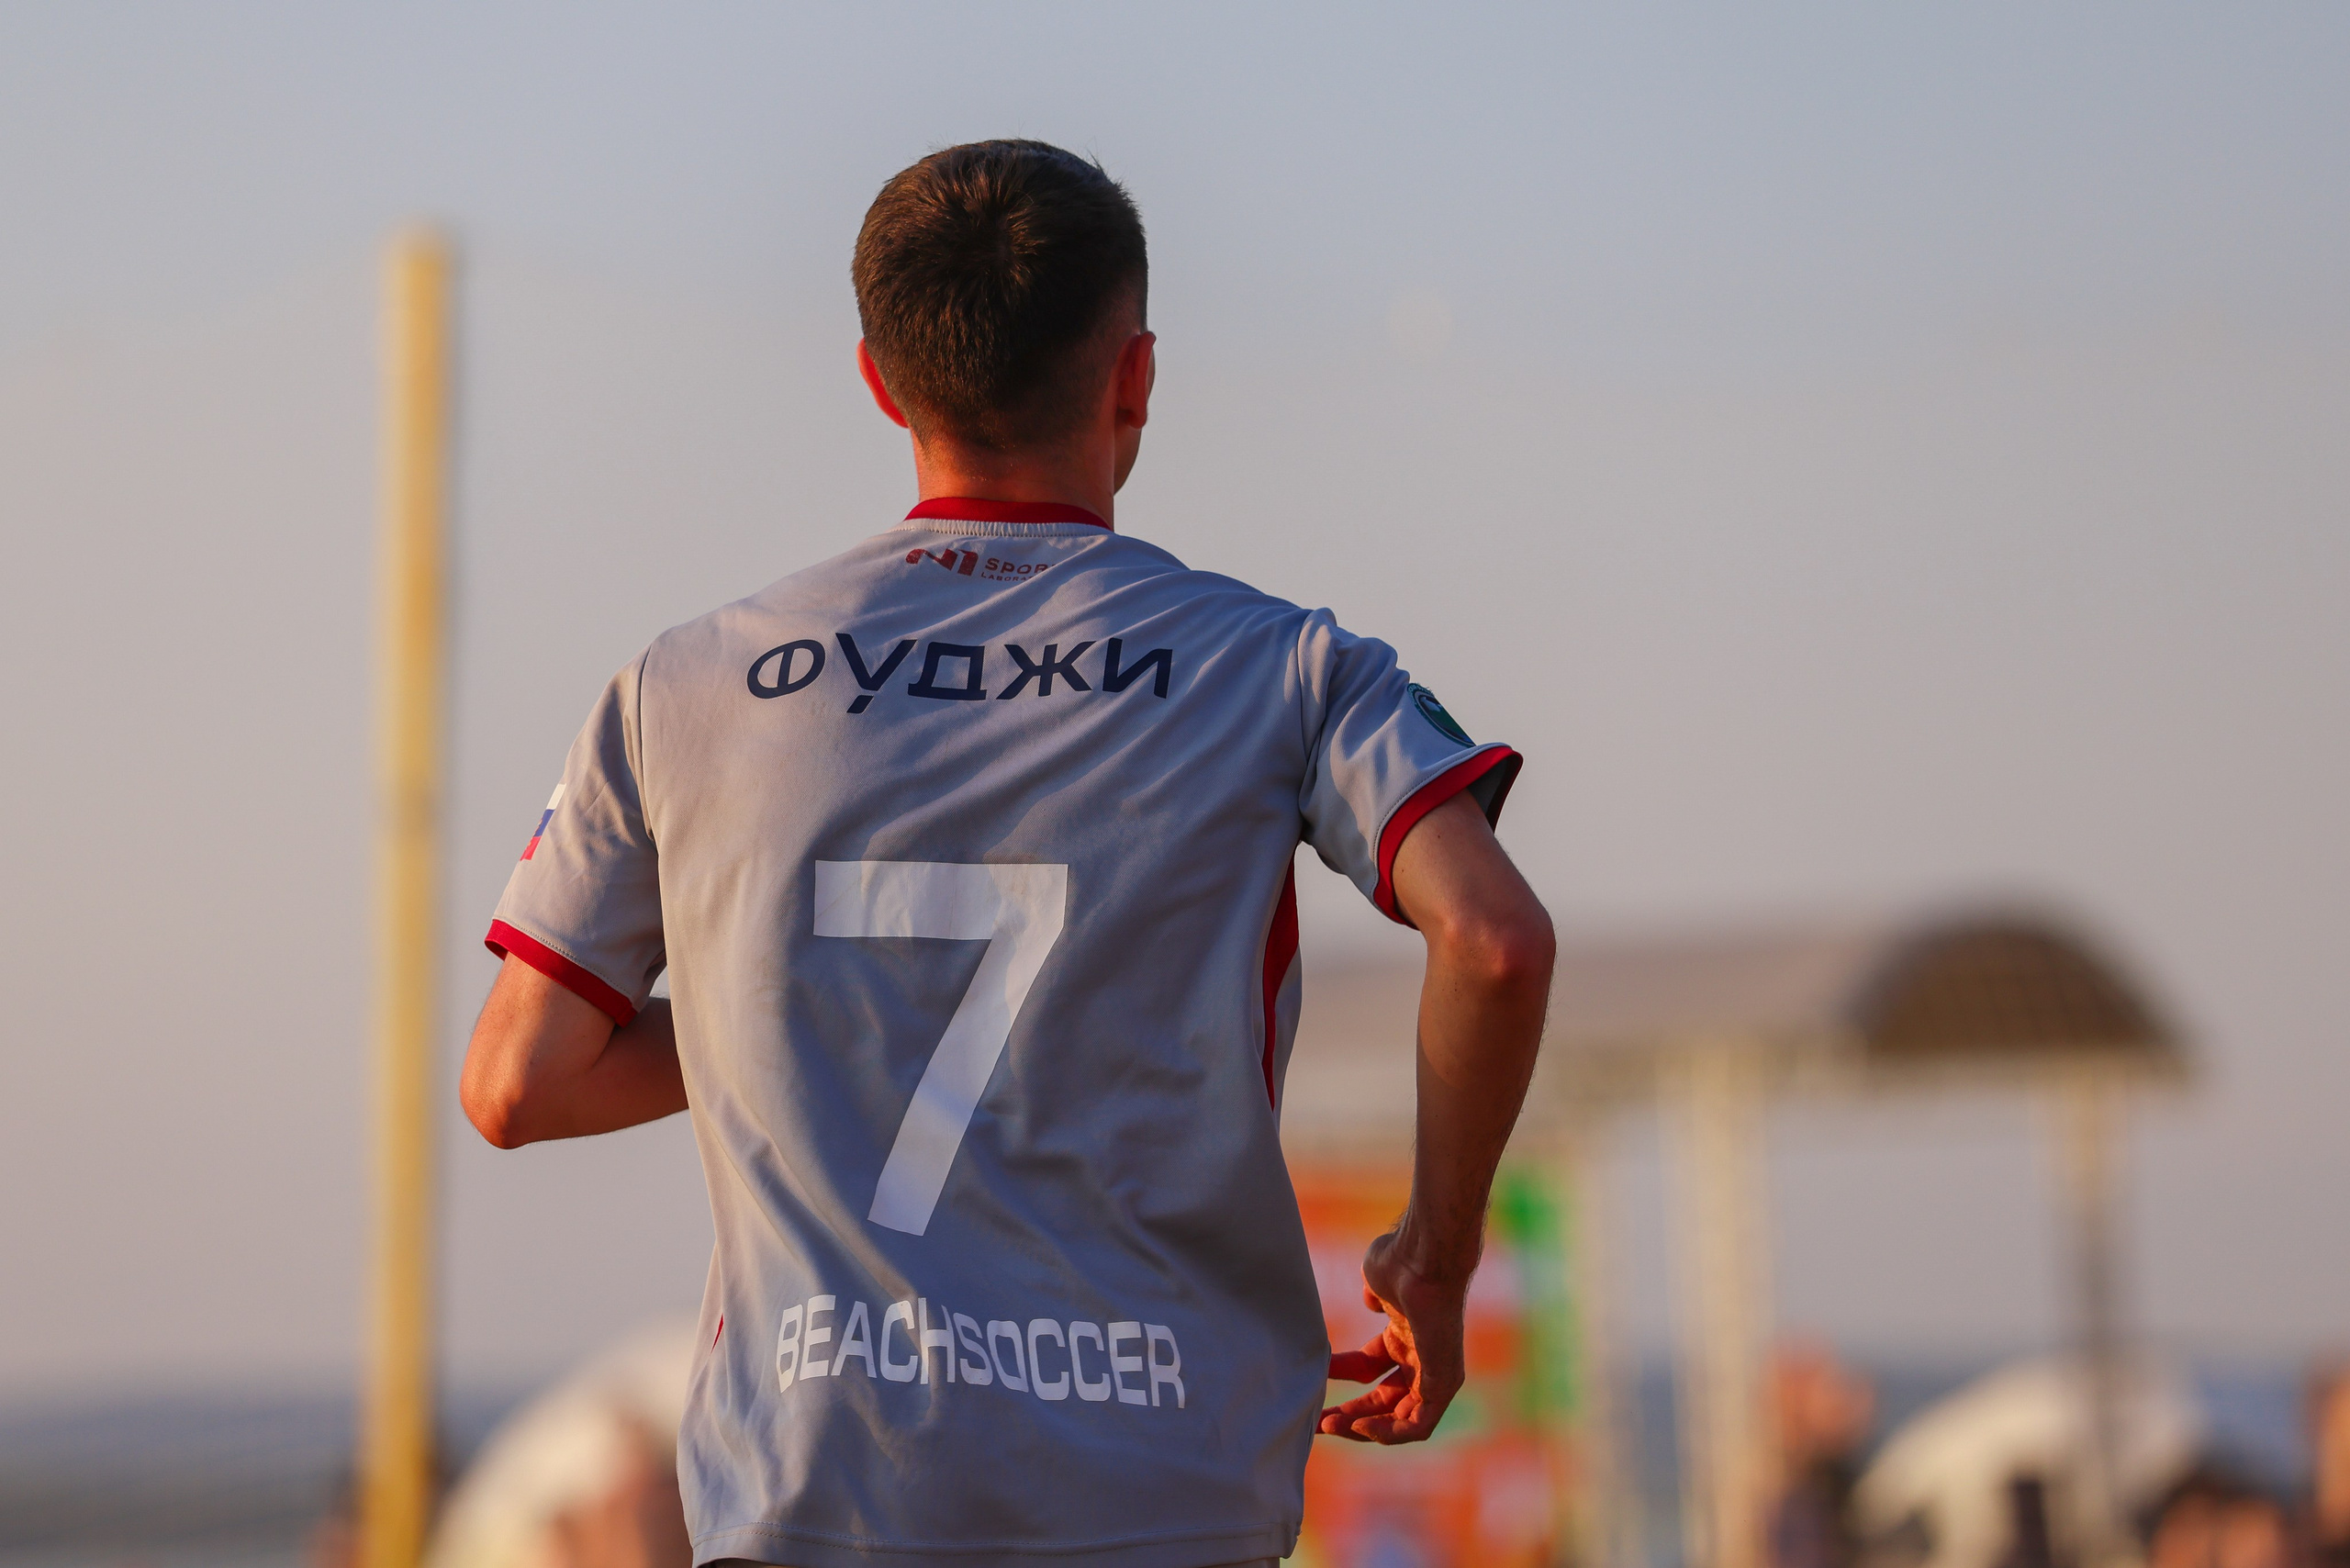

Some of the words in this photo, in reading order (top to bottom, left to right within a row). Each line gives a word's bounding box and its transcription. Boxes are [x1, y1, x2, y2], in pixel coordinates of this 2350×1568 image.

[985, 557, 1056, 575] SPOR
[746, 633, 1173, 714] ФУДЖИ
[813, 860, 1069, 1237] 7
[776, 1294, 1186, 1408] BEACHSOCCER
